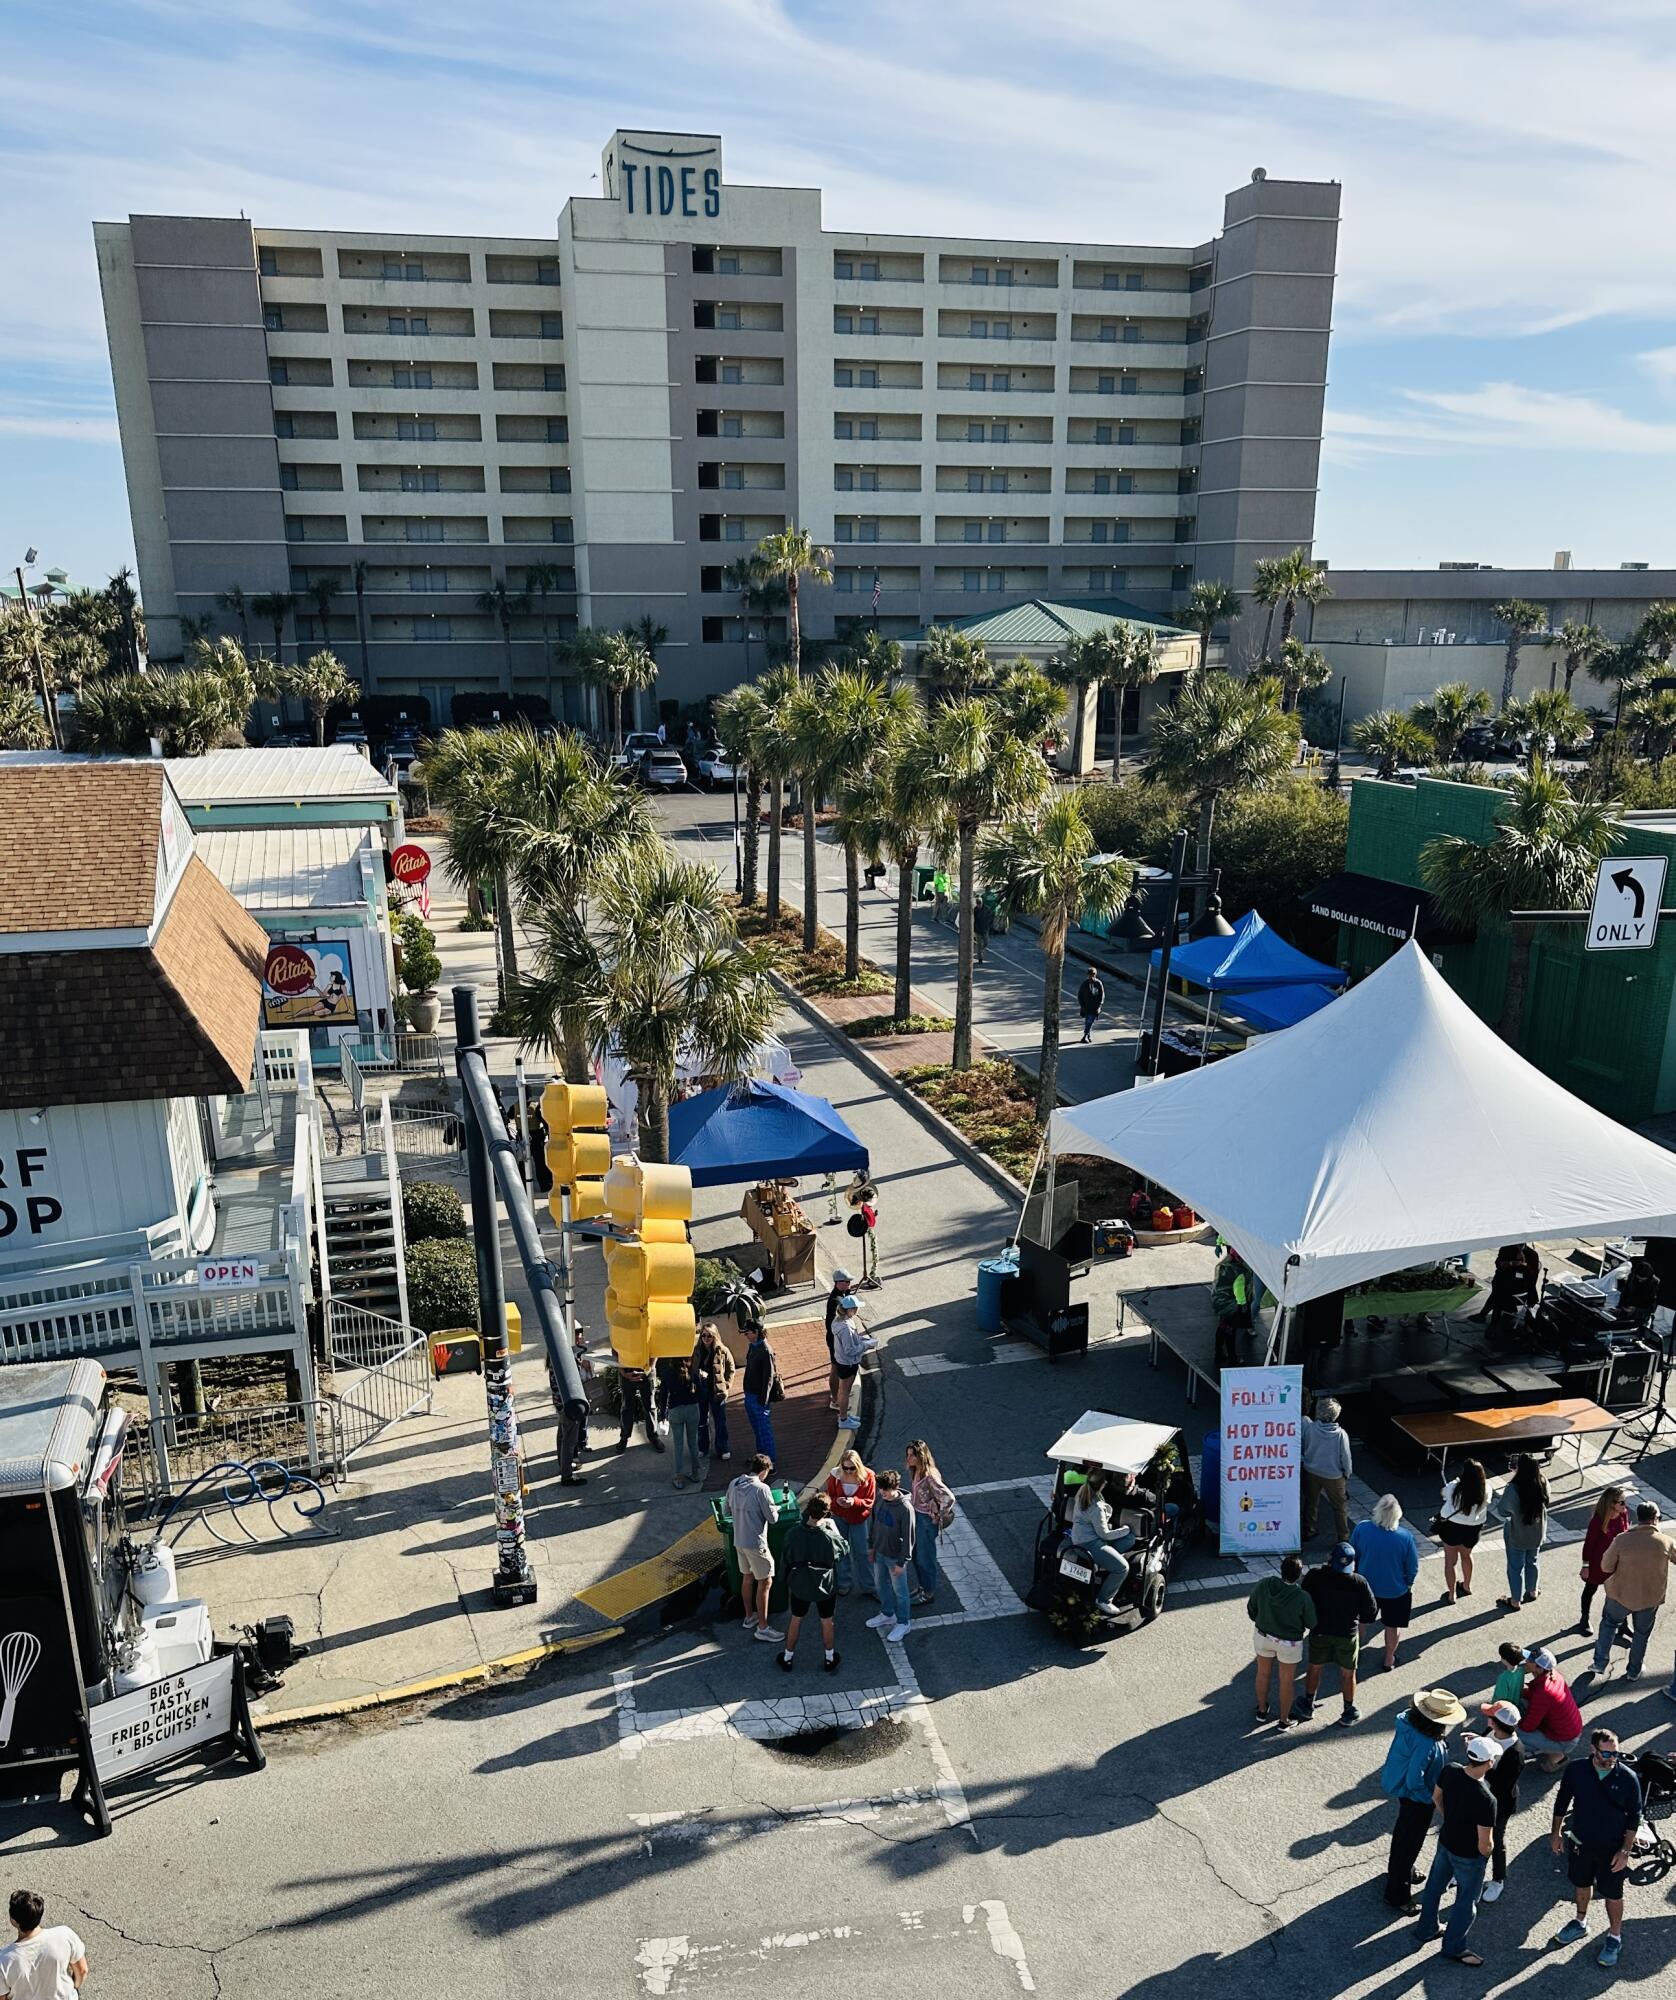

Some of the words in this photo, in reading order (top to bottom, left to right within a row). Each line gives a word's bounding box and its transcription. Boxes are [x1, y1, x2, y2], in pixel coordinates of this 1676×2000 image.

[621, 164, 720, 218] TIDES
[395, 853, 427, 876] Rita's
[1312, 904, 1329, 917] SAND
[1331, 910, 1359, 926] DOLLAR
[1360, 918, 1386, 934] SOCIAL
[1387, 926, 1407, 939] CLUB
[1596, 923, 1645, 941] ONLY
[268, 956, 315, 986] Rita's
[0, 1148, 47, 1189] F
[204, 1265, 254, 1280] OPEN
[1227, 1424, 1259, 1439] HOT
[1265, 1421, 1296, 1437] DOG
[1233, 1443, 1289, 1460] EATING
[1227, 1465, 1295, 1481] CONTEST
[1239, 1520, 1281, 1532] FOLLY
[150, 1682, 170, 1701] BIG
[177, 1677, 185, 1689] &
[150, 1689, 191, 1714] TASTY
[112, 1720, 149, 1745] FRIED
[155, 1696, 209, 1727] CHICKEN
[134, 1716, 196, 1750] BISCUITS!
